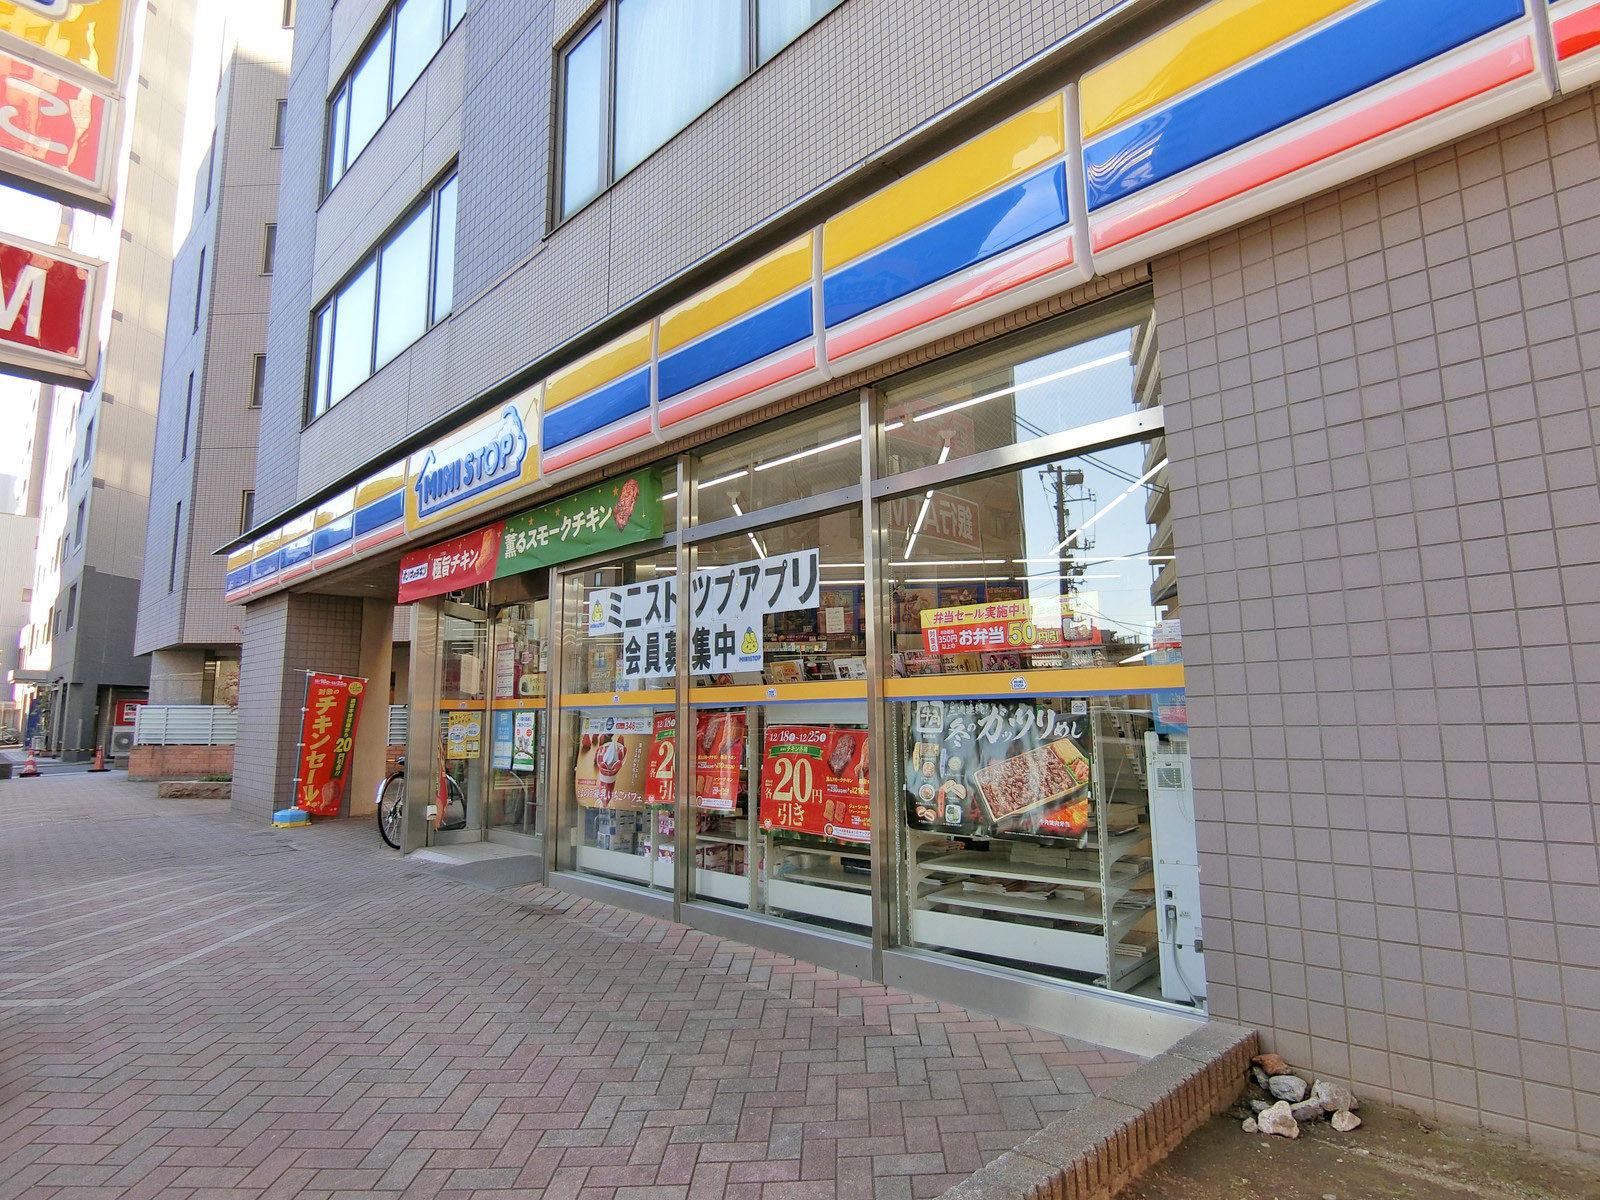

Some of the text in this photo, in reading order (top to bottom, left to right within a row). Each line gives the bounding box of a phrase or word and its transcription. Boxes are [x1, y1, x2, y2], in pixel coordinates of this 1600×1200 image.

[423, 433, 515, 504] MINI STOP
[504, 505, 613, 559] 薫るスモークチキン
[432, 550, 479, 580] 極旨チキン
[933, 603, 1027, 625] 弁当セール実施中!
[939, 634, 958, 644] 350円
[959, 627, 1005, 646] お弁当
[303, 695, 338, 802] チキンセール
[777, 802, 806, 826] 引き
